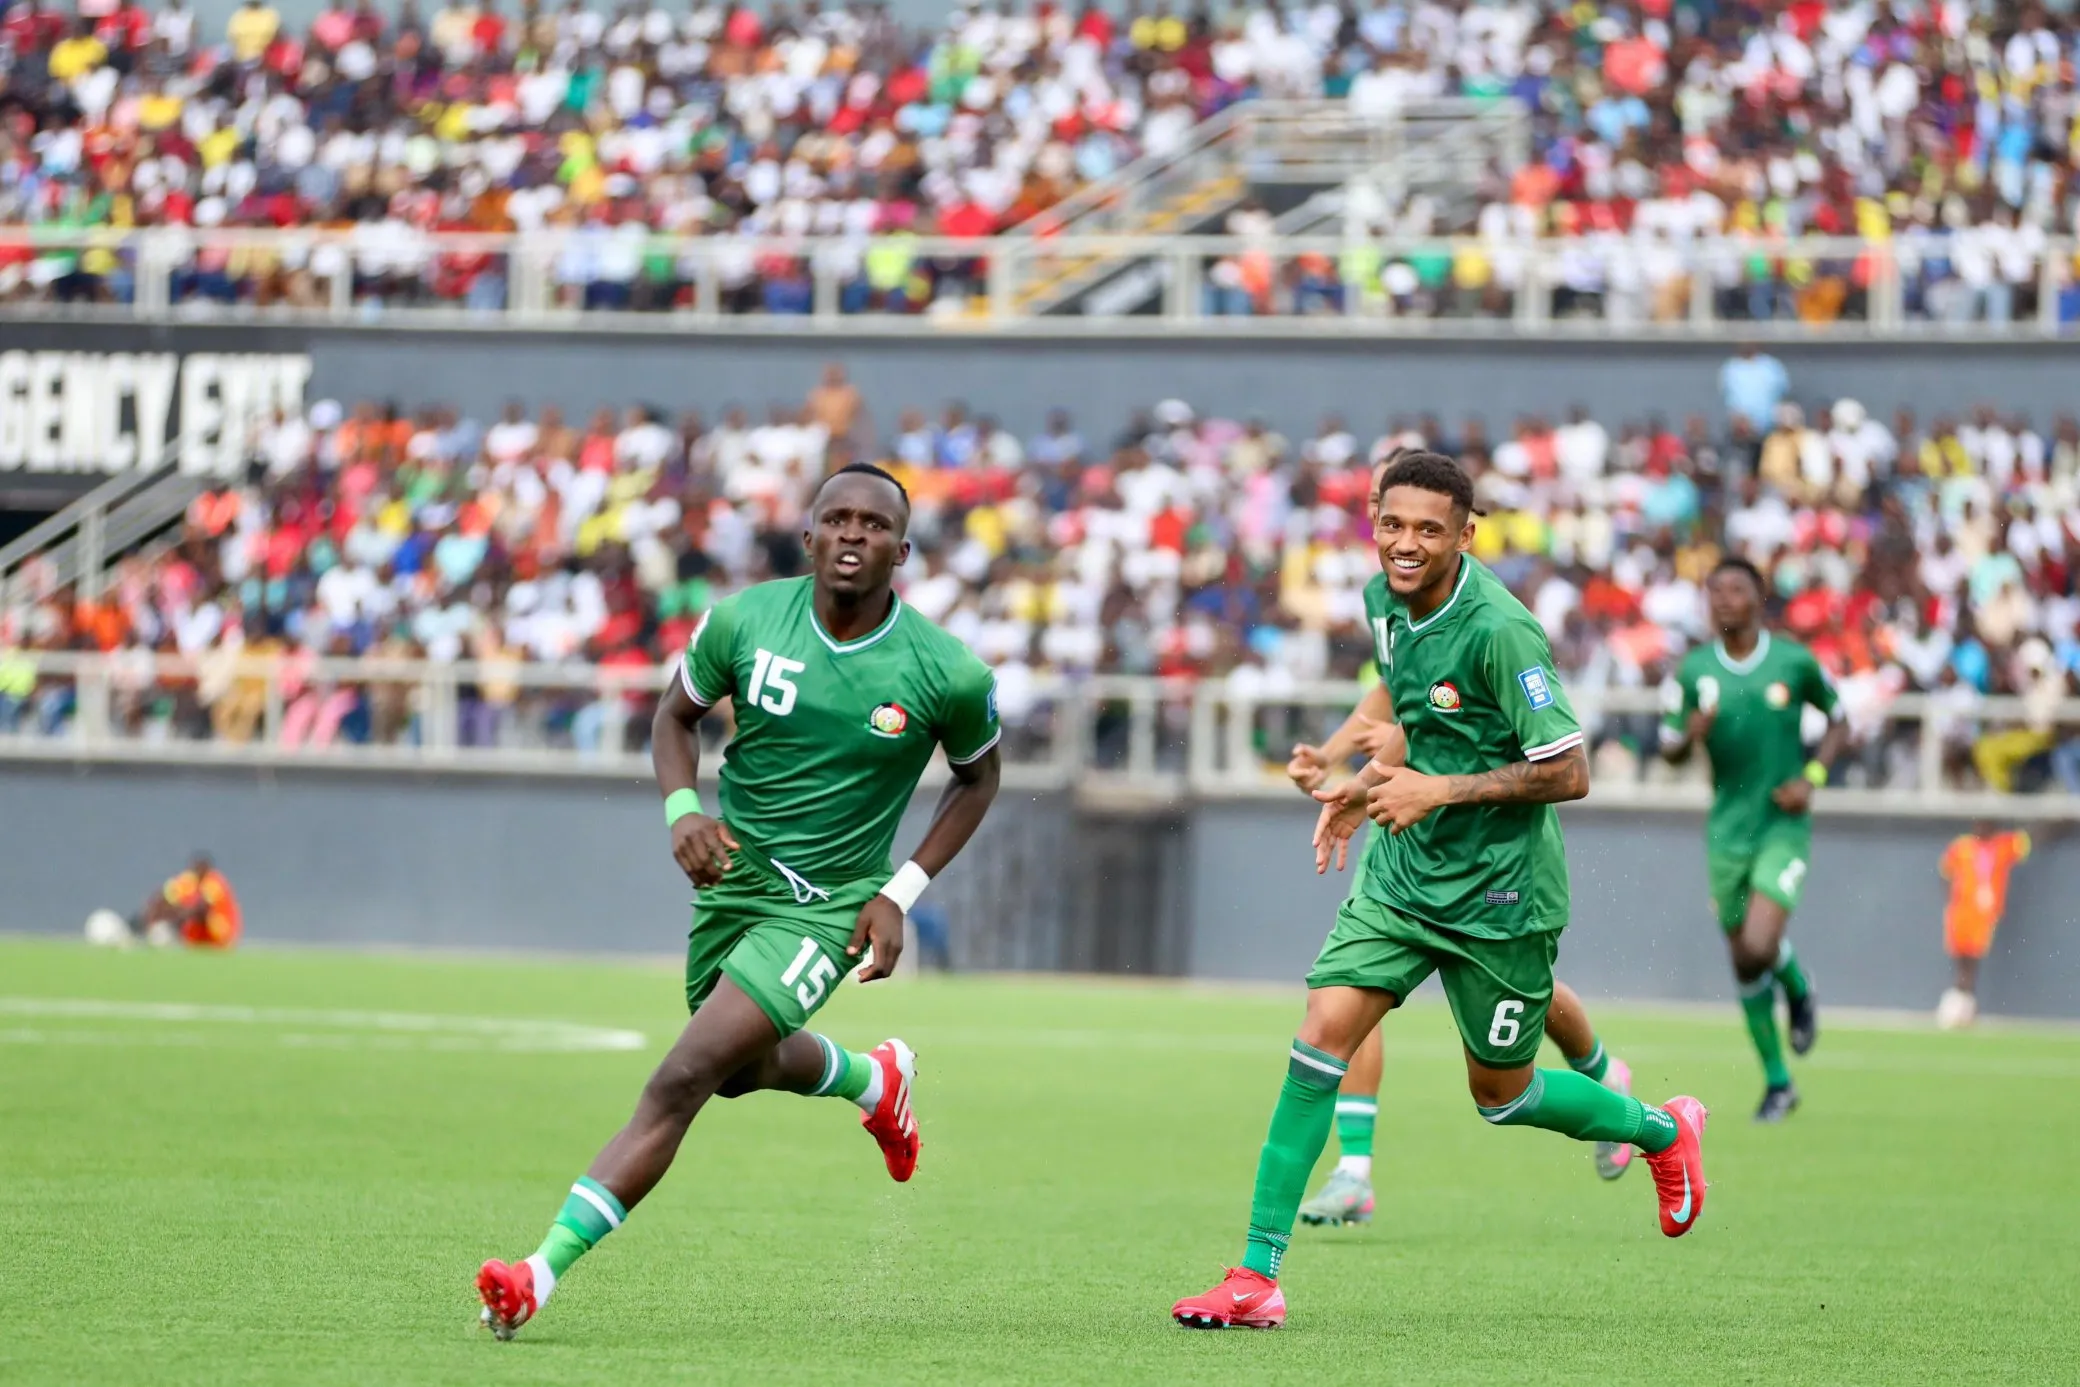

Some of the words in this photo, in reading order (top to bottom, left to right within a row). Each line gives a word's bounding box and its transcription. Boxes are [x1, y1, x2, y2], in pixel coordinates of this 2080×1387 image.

[747, 648, 805, 716] 15
[780, 936, 838, 1010] 15
[1488, 1000, 1524, 1047] 6
